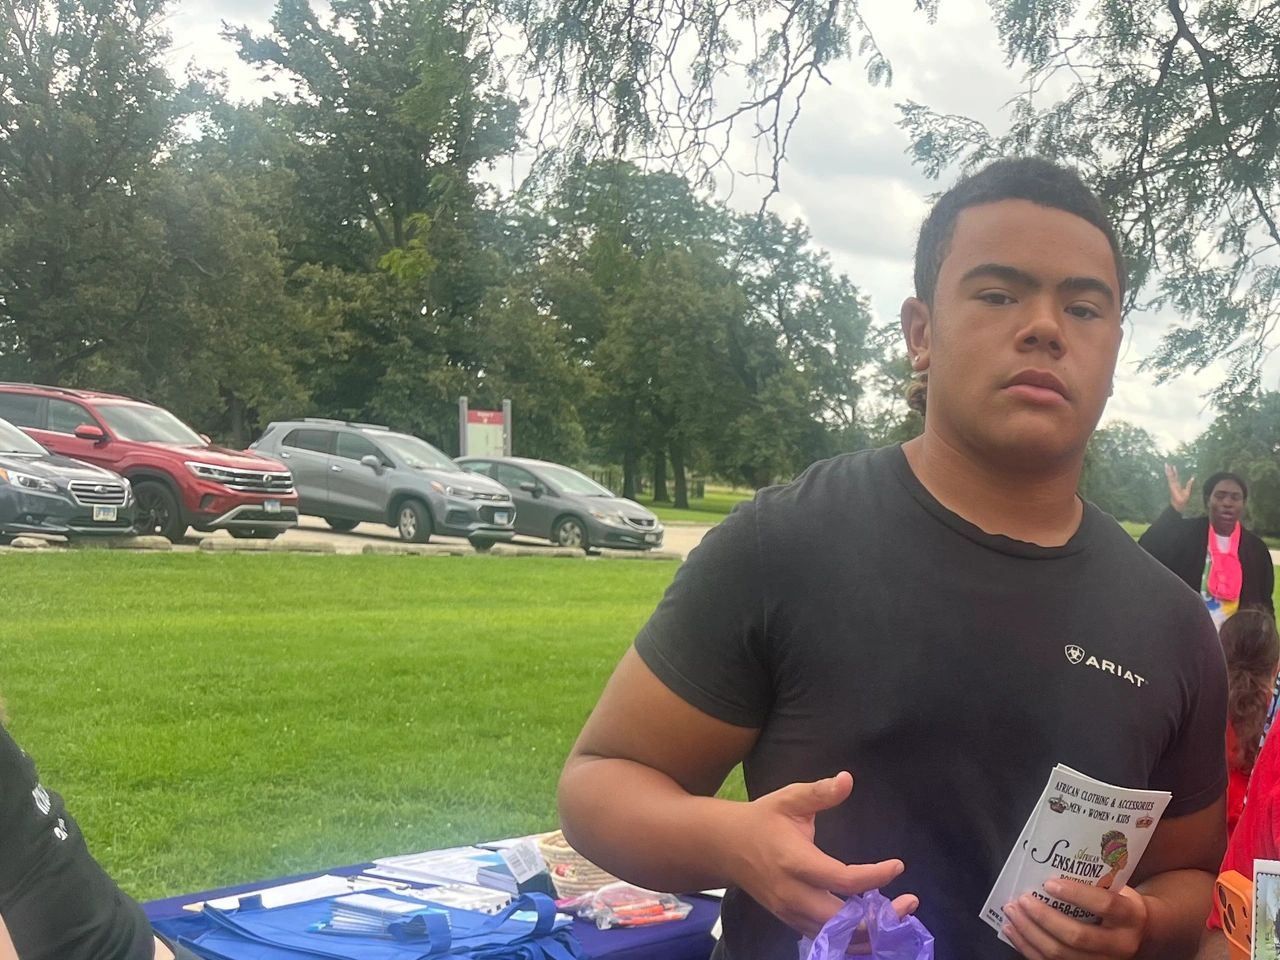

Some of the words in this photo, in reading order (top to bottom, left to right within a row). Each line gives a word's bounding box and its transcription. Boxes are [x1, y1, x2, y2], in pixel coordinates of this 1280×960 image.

[1085, 655, 1145, 687] ARIAT
[1055, 781, 1079, 797] AFRICAN
[1081, 790, 1110, 806] CLOTHING
[1111, 798, 1116, 808] &
[1117, 799, 1155, 811] ACCESSORIES
[1069, 802, 1082, 814] MEN
[1088, 808, 1111, 821] WOMEN
[1116, 814, 1131, 824] KIDS
[1031, 839, 1105, 879] SENSATIONZ
